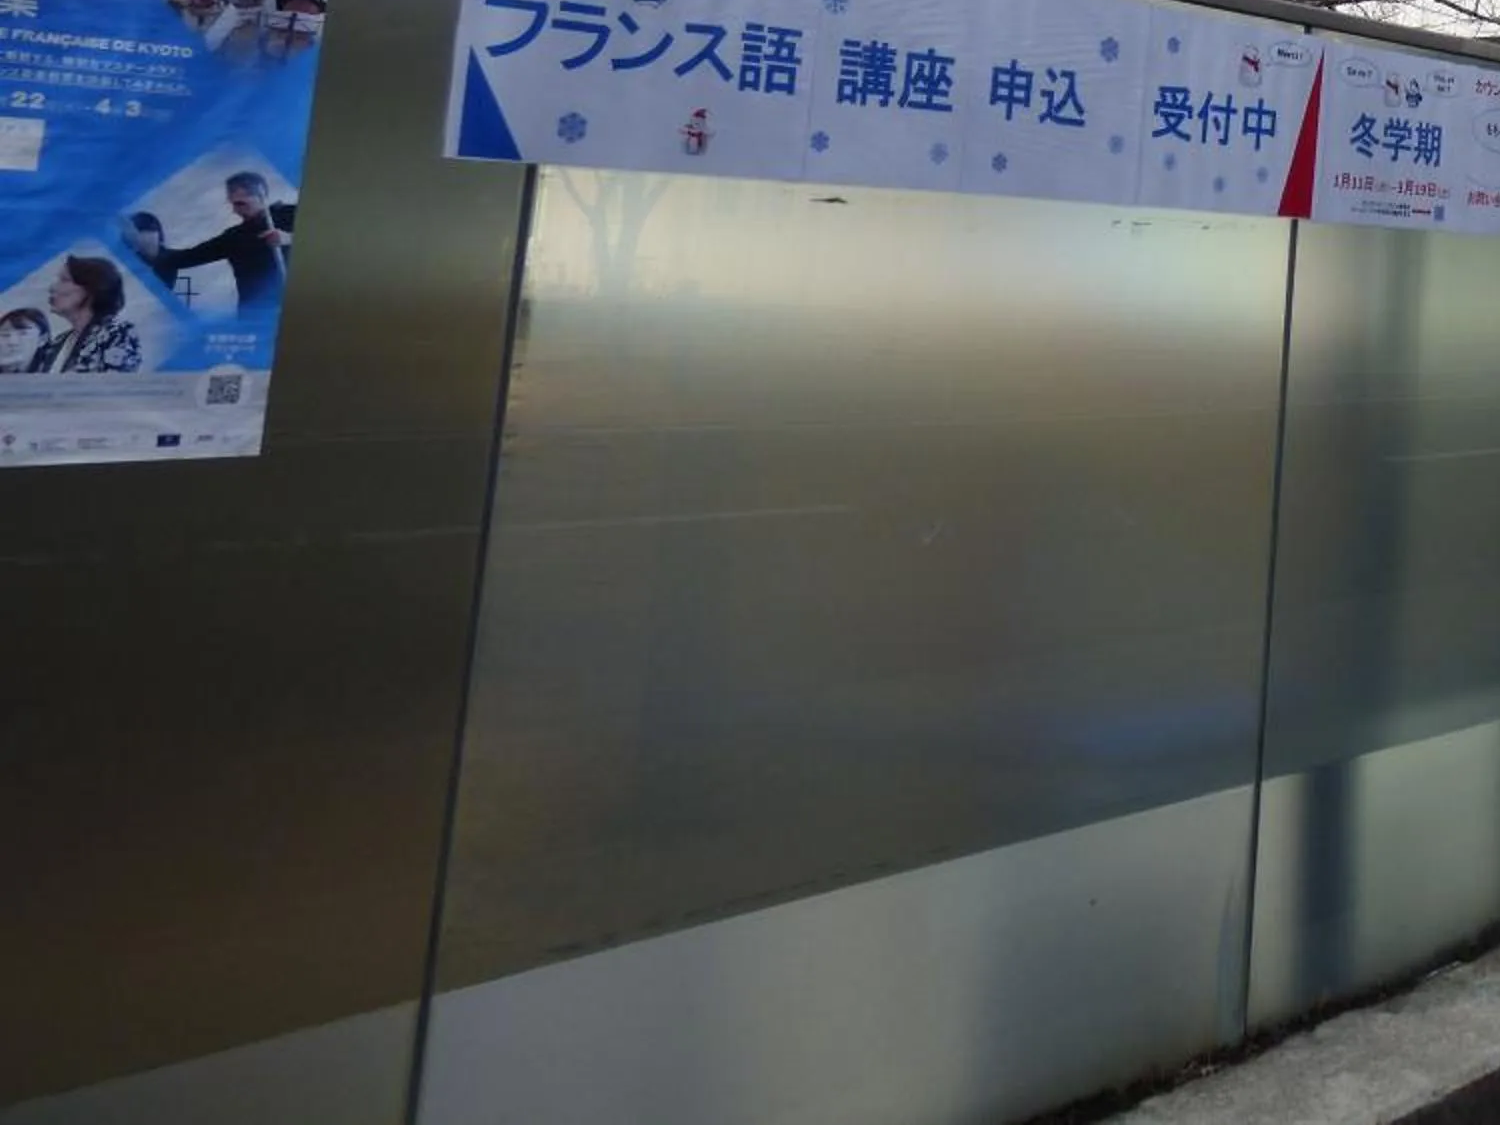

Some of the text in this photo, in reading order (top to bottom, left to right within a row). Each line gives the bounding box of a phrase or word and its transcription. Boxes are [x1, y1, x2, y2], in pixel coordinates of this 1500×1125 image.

[12, 28, 109, 50] FRANÇAISE
[112, 40, 136, 53] DE
[138, 42, 193, 59] KYOTO
[836, 38, 956, 113] 講座
[989, 59, 1086, 128] 申込
[1151, 85, 1278, 151] 受付中
[1350, 112, 1443, 168] 冬学期
